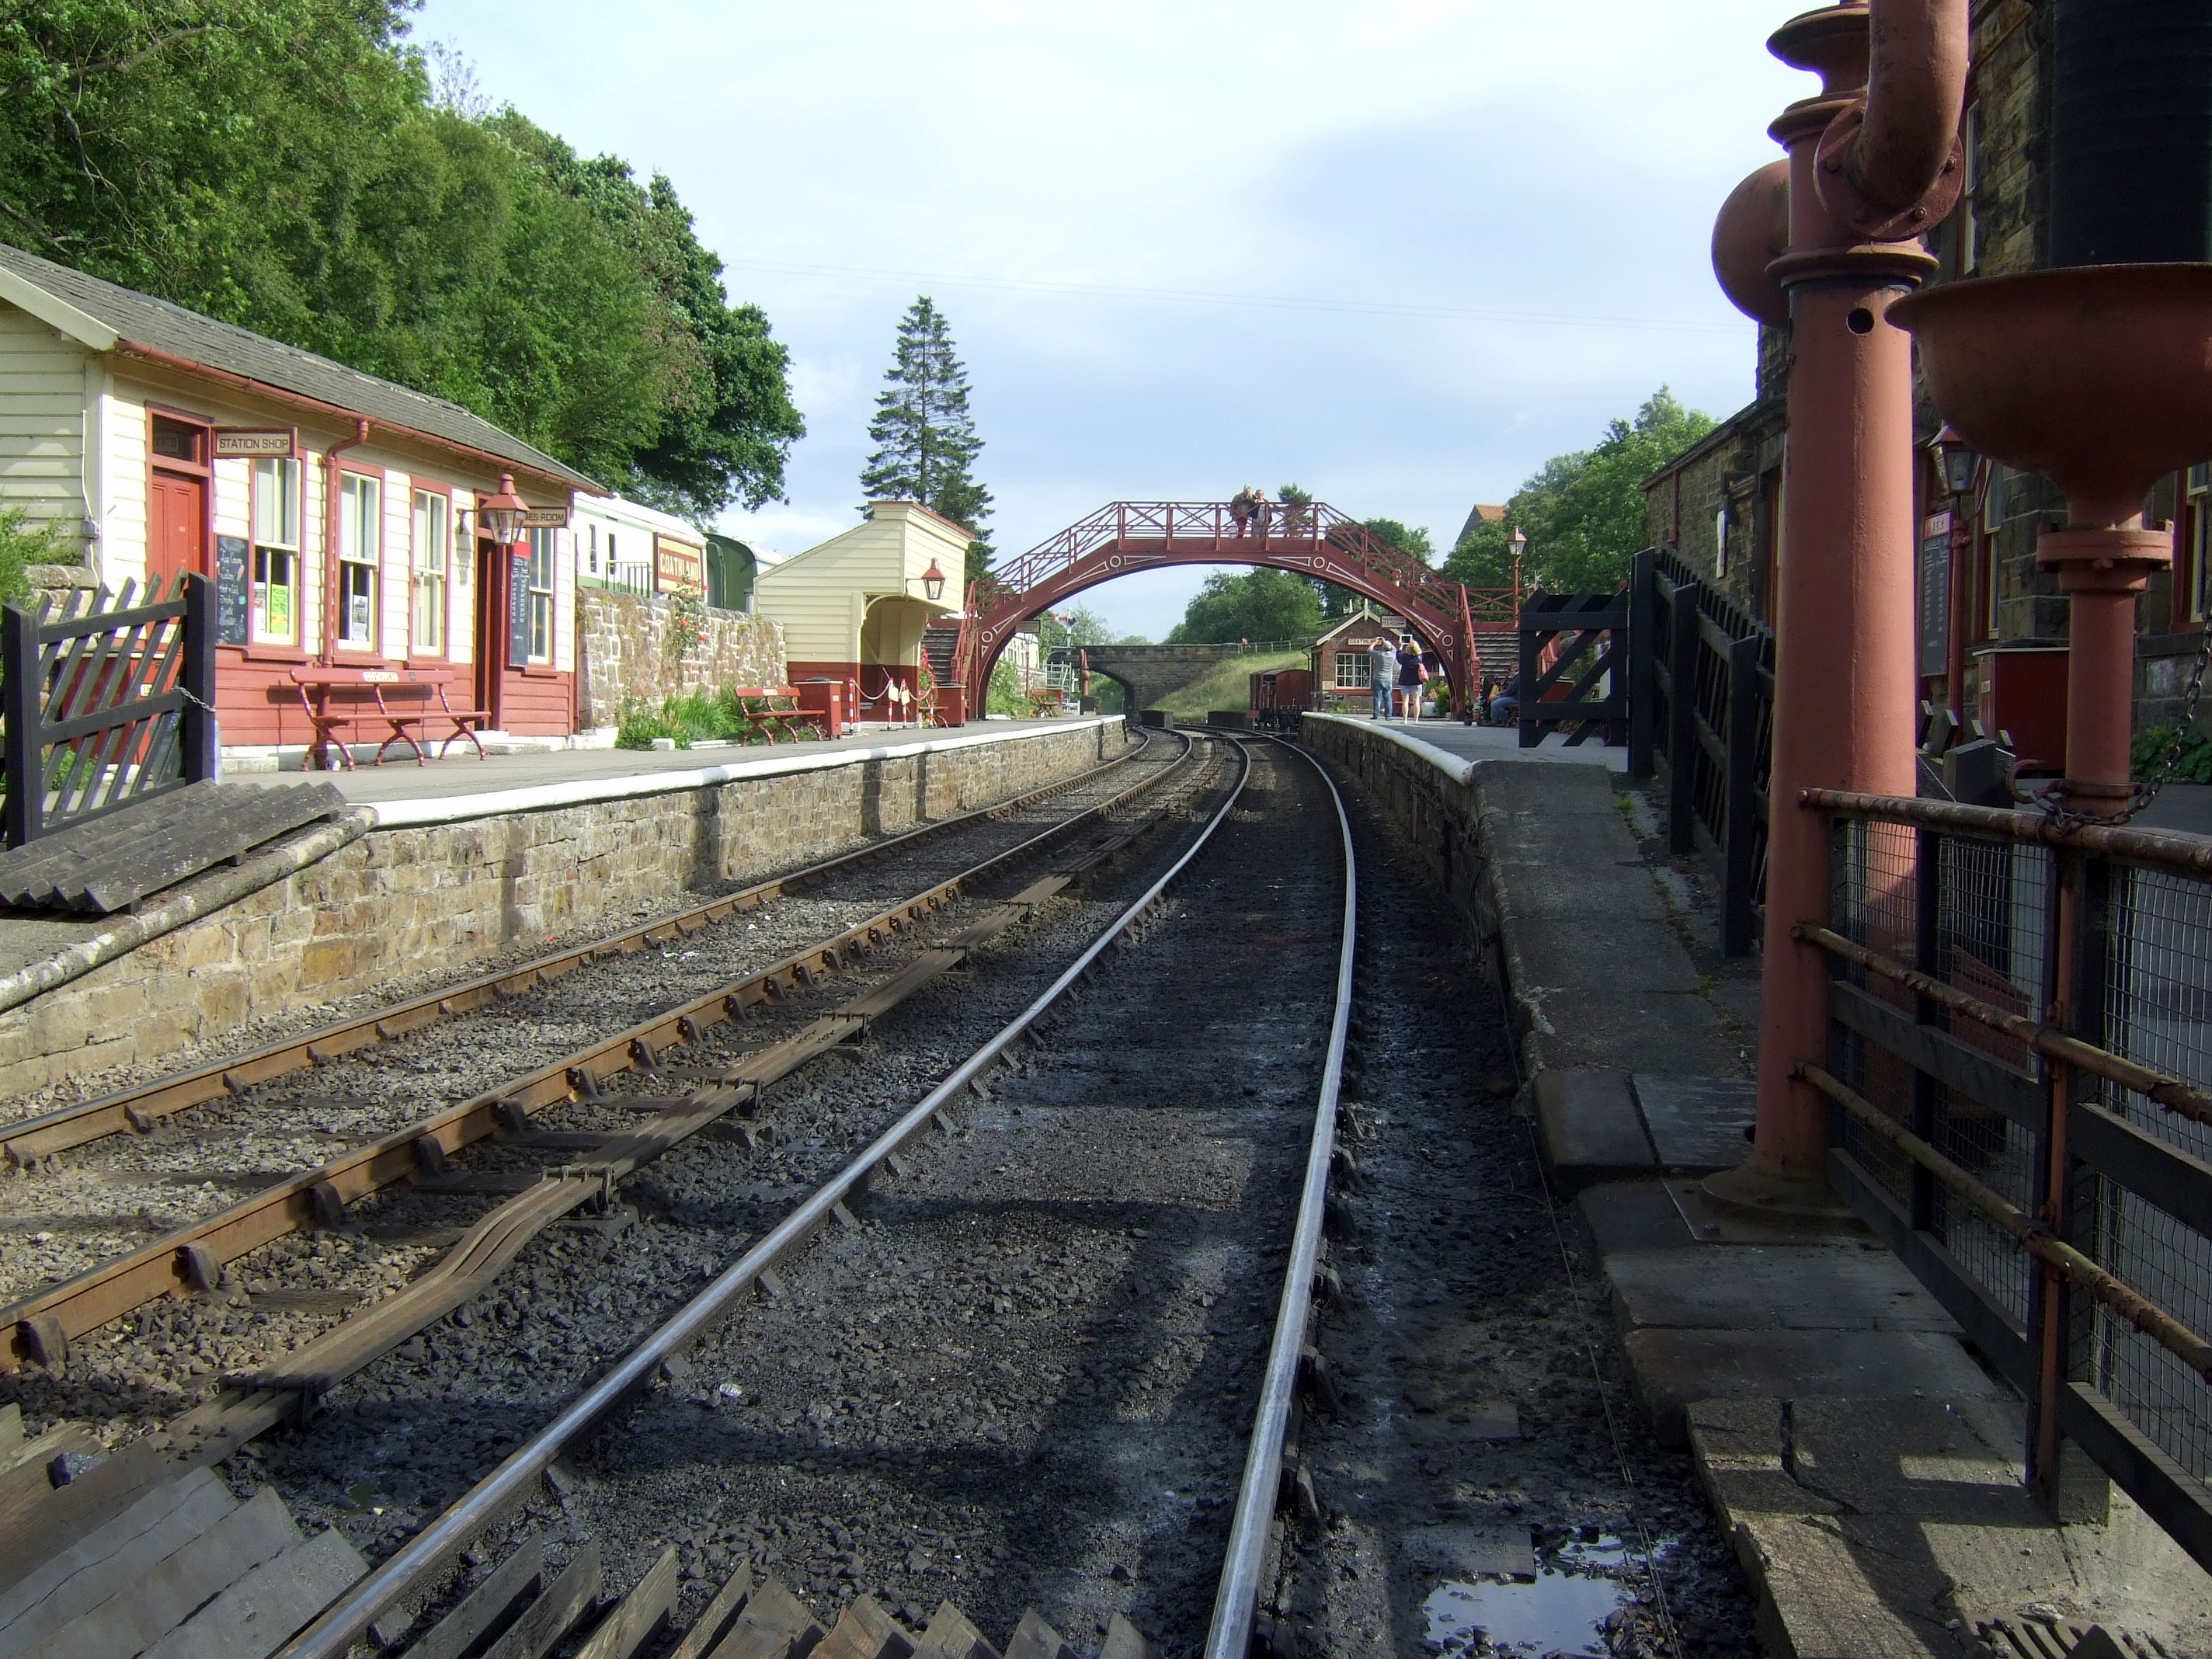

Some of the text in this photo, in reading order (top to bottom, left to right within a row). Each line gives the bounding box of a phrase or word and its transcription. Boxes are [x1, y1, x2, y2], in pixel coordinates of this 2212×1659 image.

[219, 438, 289, 449] STATION SHOP
[540, 513, 565, 521] ROOM
[659, 552, 699, 583] GOATHLAND
